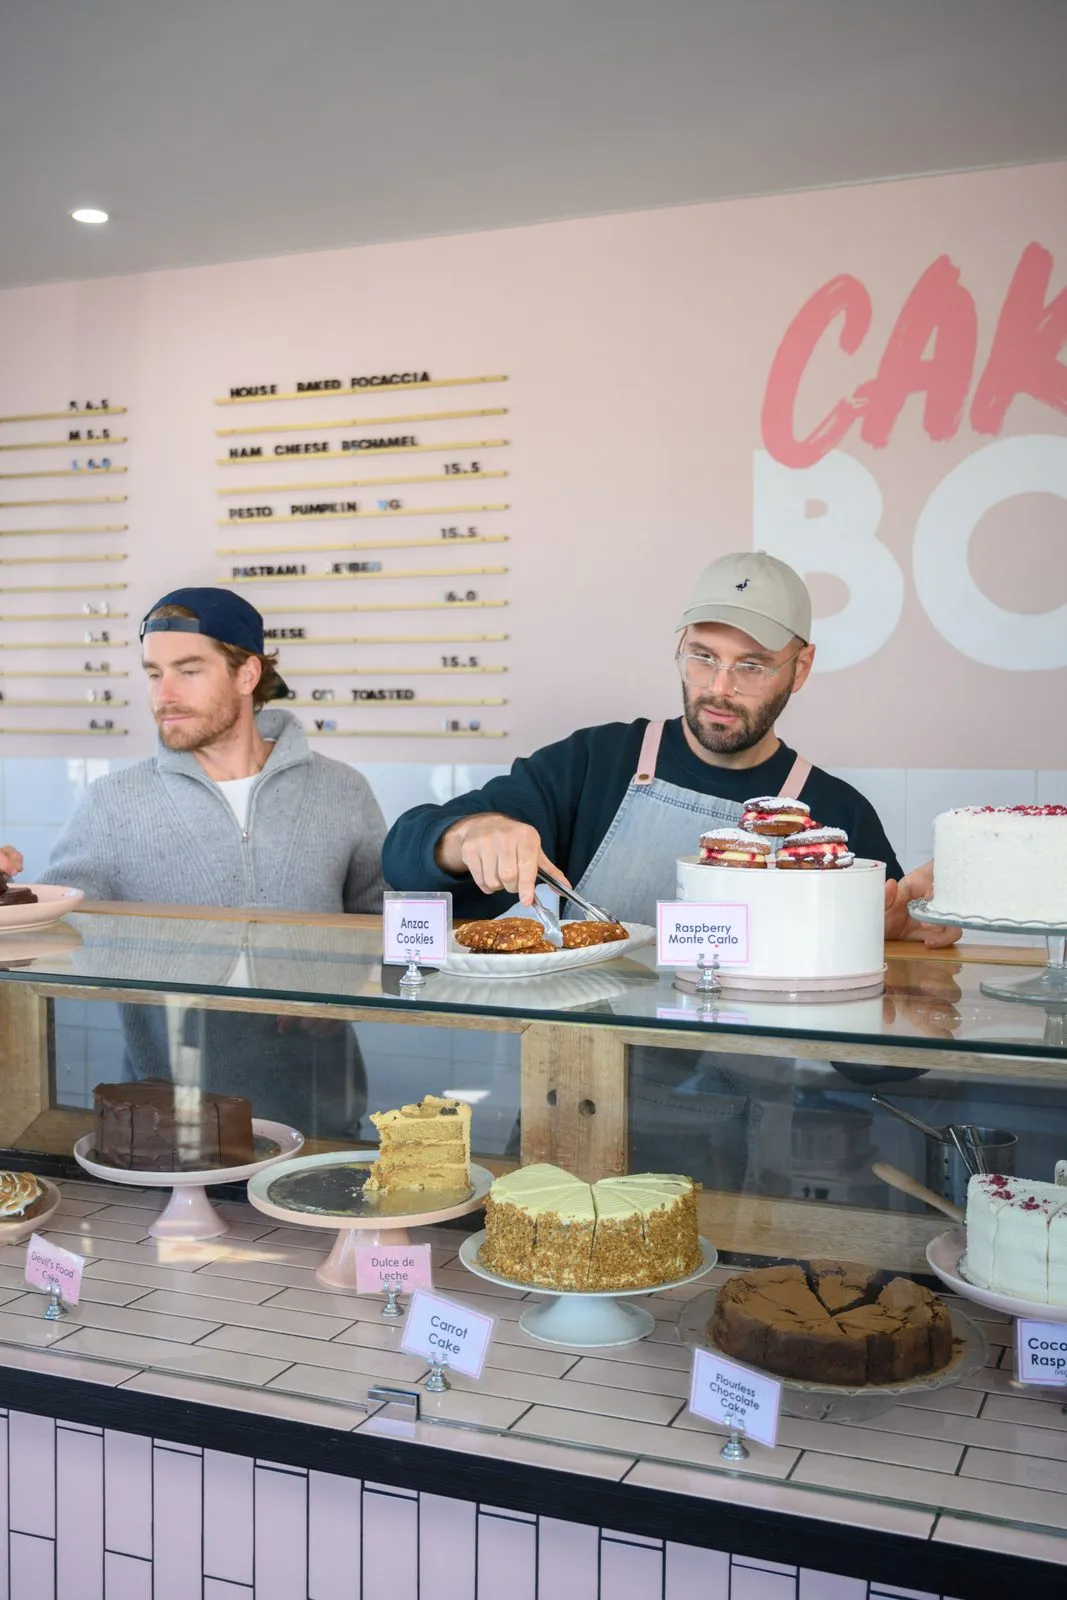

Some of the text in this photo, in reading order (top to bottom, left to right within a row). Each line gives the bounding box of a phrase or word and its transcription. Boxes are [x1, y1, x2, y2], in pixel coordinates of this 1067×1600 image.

[230, 371, 430, 399] HOUSE BAKED FOCACCIA
[69, 430, 80, 442] M
[230, 436, 418, 458] HAM CHEESE BECHAMEL
[444, 462, 480, 475] 15.5
[229, 506, 272, 519] PESTO
[290, 502, 357, 516] PUMPKIN
[440, 527, 477, 539] 15.5
[232, 565, 306, 578] PASTRAMI
[441, 655, 478, 668] 15.5
[352, 689, 414, 702] TOASTED
[401, 917, 430, 929] Anzac
[676, 923, 731, 935] Raspberry
[397, 932, 434, 945] Cookies
[669, 934, 739, 944] Monte Carlo
[372, 1257, 415, 1267] Dulce de
[56, 1263, 74, 1278] Food
[379, 1271, 409, 1281] Leche
[431, 1316, 468, 1339] Carrot
[428, 1333, 461, 1354] Cake
[1028, 1338, 1067, 1351] Coco
[1031, 1354, 1066, 1369] Rasp
[716, 1373, 755, 1397] Flourless
[709, 1382, 760, 1410] Chocolate
[720, 1398, 746, 1415] Cake
